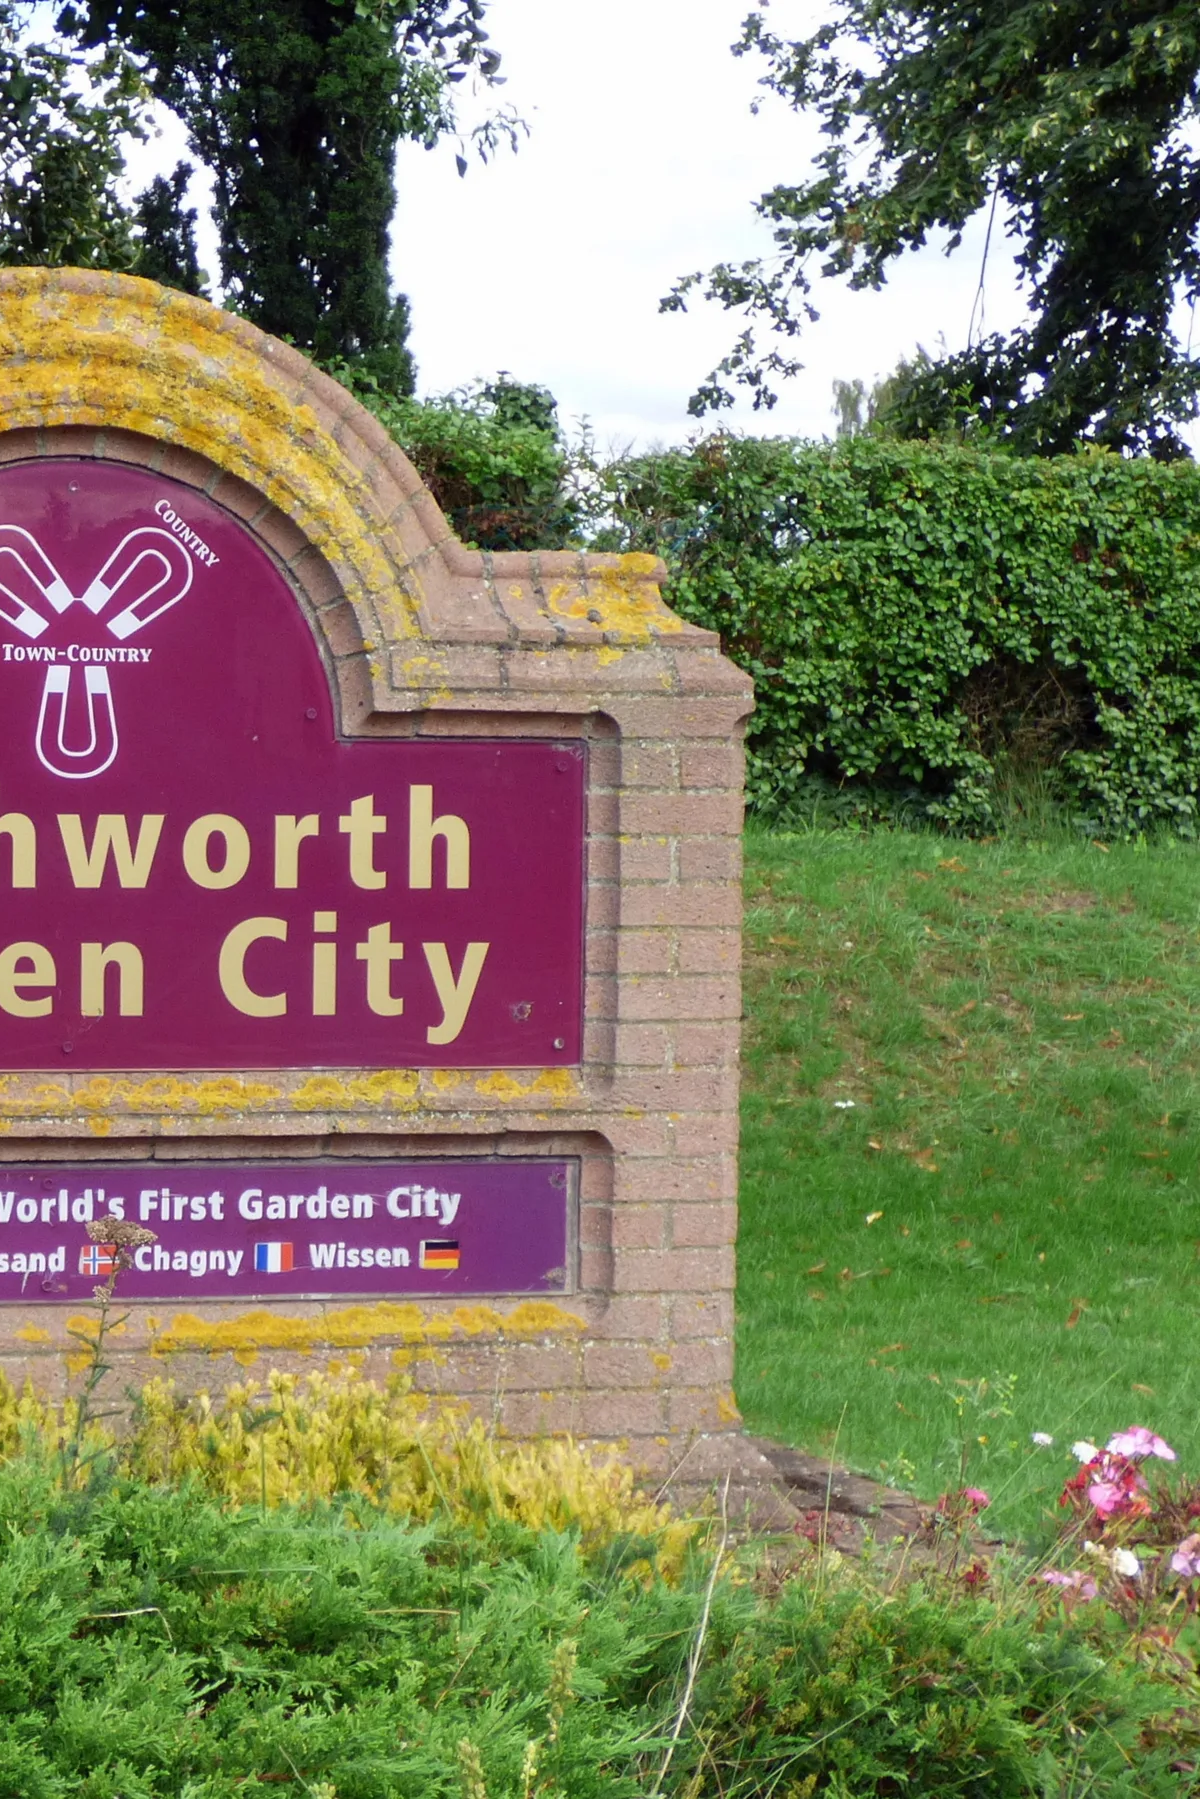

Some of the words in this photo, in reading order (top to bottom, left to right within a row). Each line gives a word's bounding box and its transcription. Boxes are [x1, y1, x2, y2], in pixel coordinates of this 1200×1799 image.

[218, 911, 489, 1045] City
[139, 1188, 224, 1220] First
[238, 1186, 373, 1219] Garden
[387, 1185, 460, 1225] City
[134, 1245, 243, 1276] Chagny
[309, 1243, 410, 1268] Wissen
